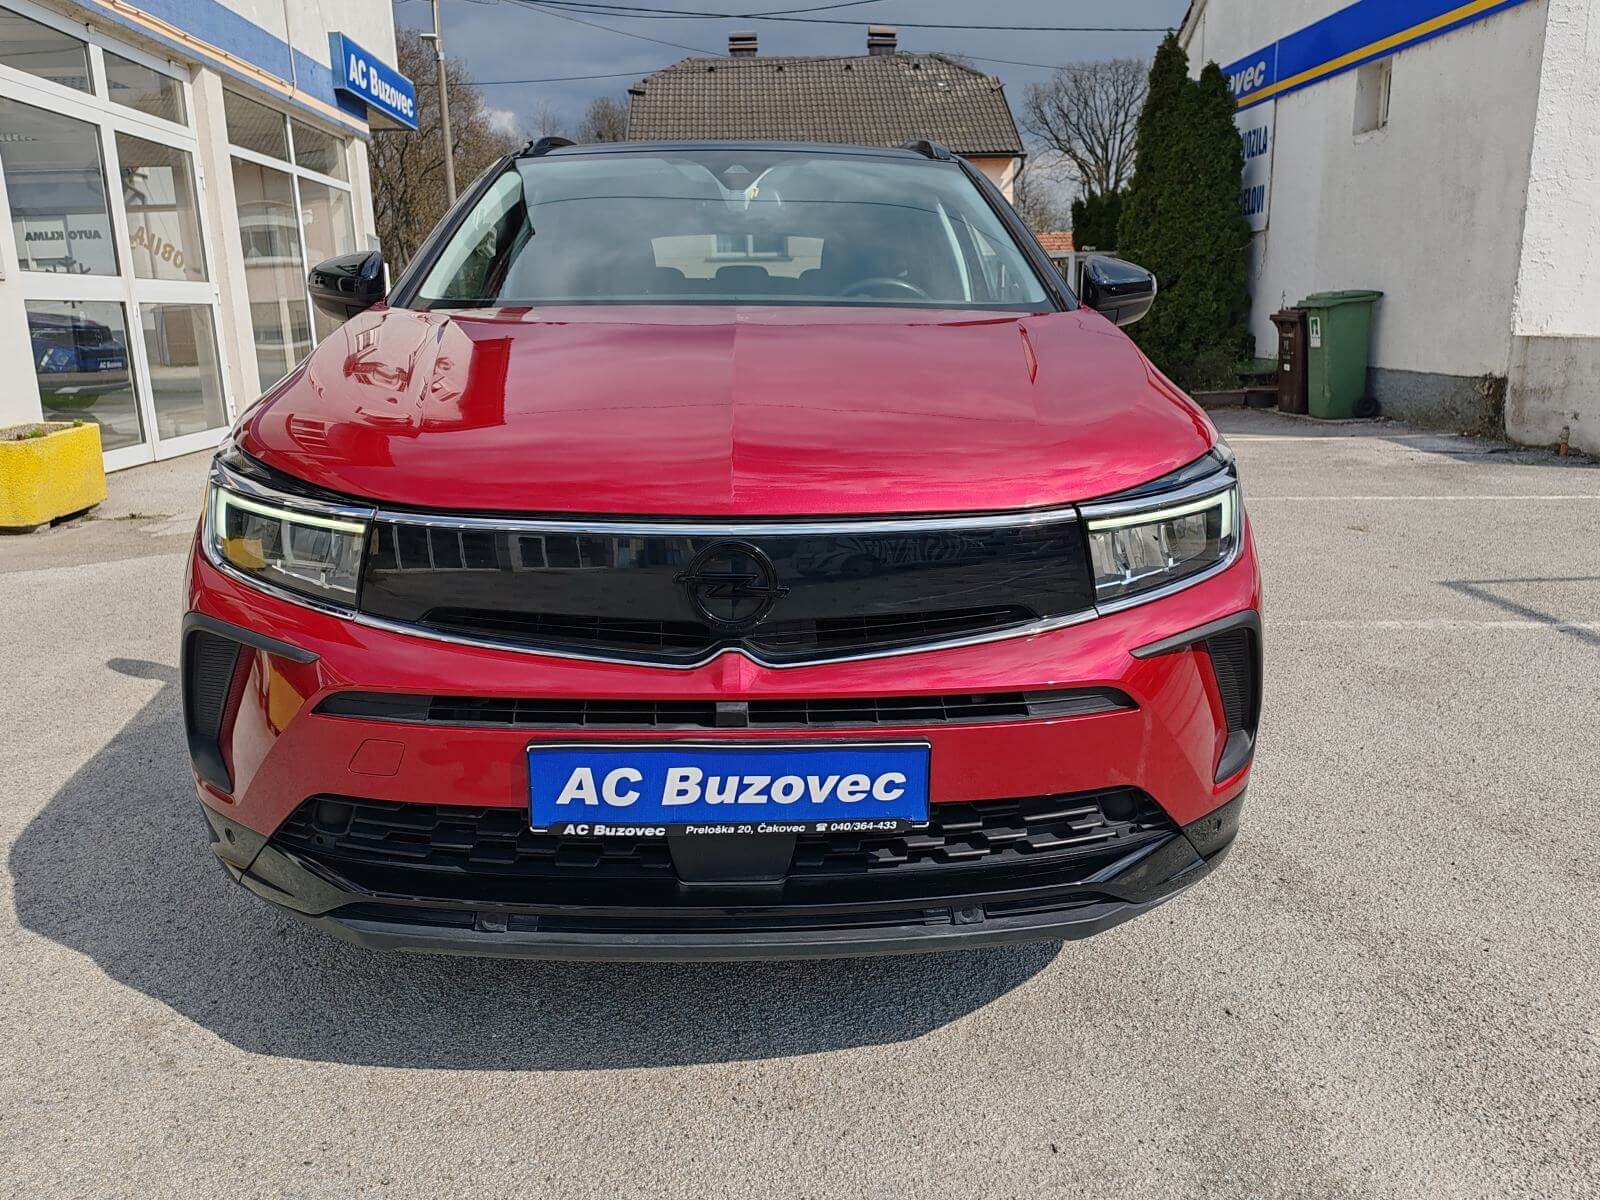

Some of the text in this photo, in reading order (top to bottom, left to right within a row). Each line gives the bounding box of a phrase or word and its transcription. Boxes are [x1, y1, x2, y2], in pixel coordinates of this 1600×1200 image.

[349, 53, 414, 118] AC Buzovec
[555, 766, 907, 807] AC Buzovec
[563, 821, 897, 836] AC Buzovec Preloška 20, Čakovec 040/364-433
